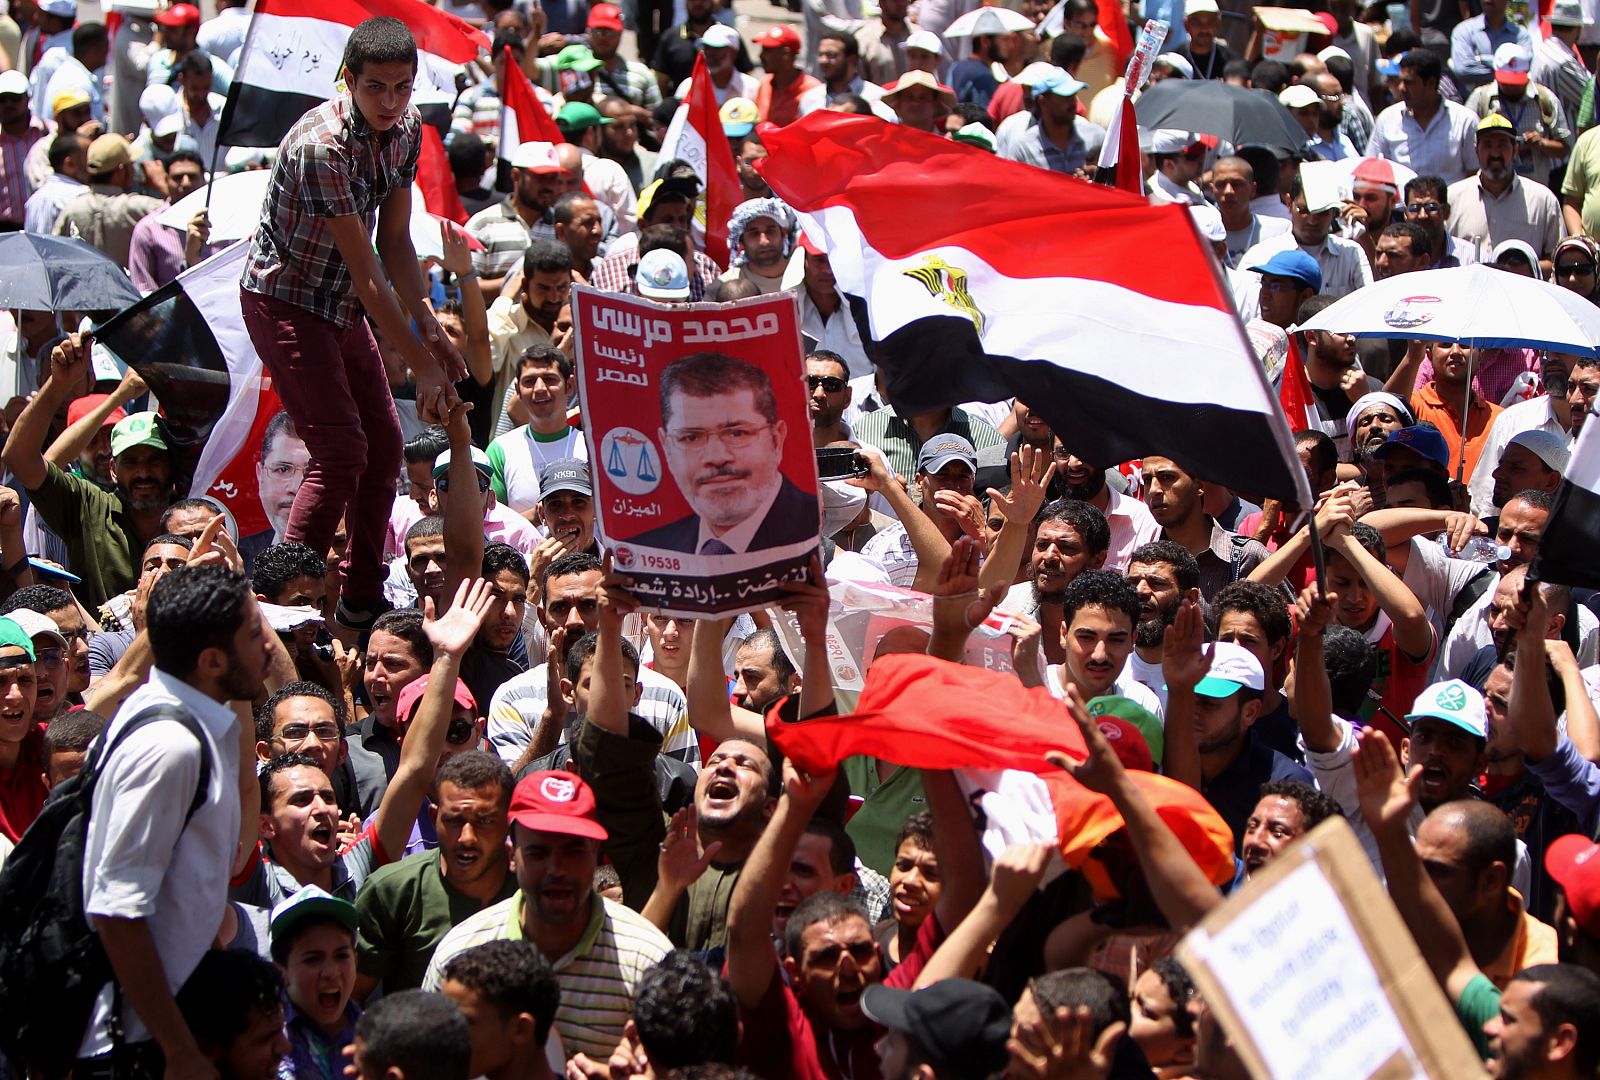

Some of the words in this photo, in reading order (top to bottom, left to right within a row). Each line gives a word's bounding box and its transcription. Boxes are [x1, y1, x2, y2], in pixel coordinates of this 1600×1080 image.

[682, 312, 780, 344] محمد
[596, 366, 649, 387] لمصر
[553, 470, 577, 480] NK90
[612, 498, 662, 516] الميزان
[640, 554, 681, 571] 19538
